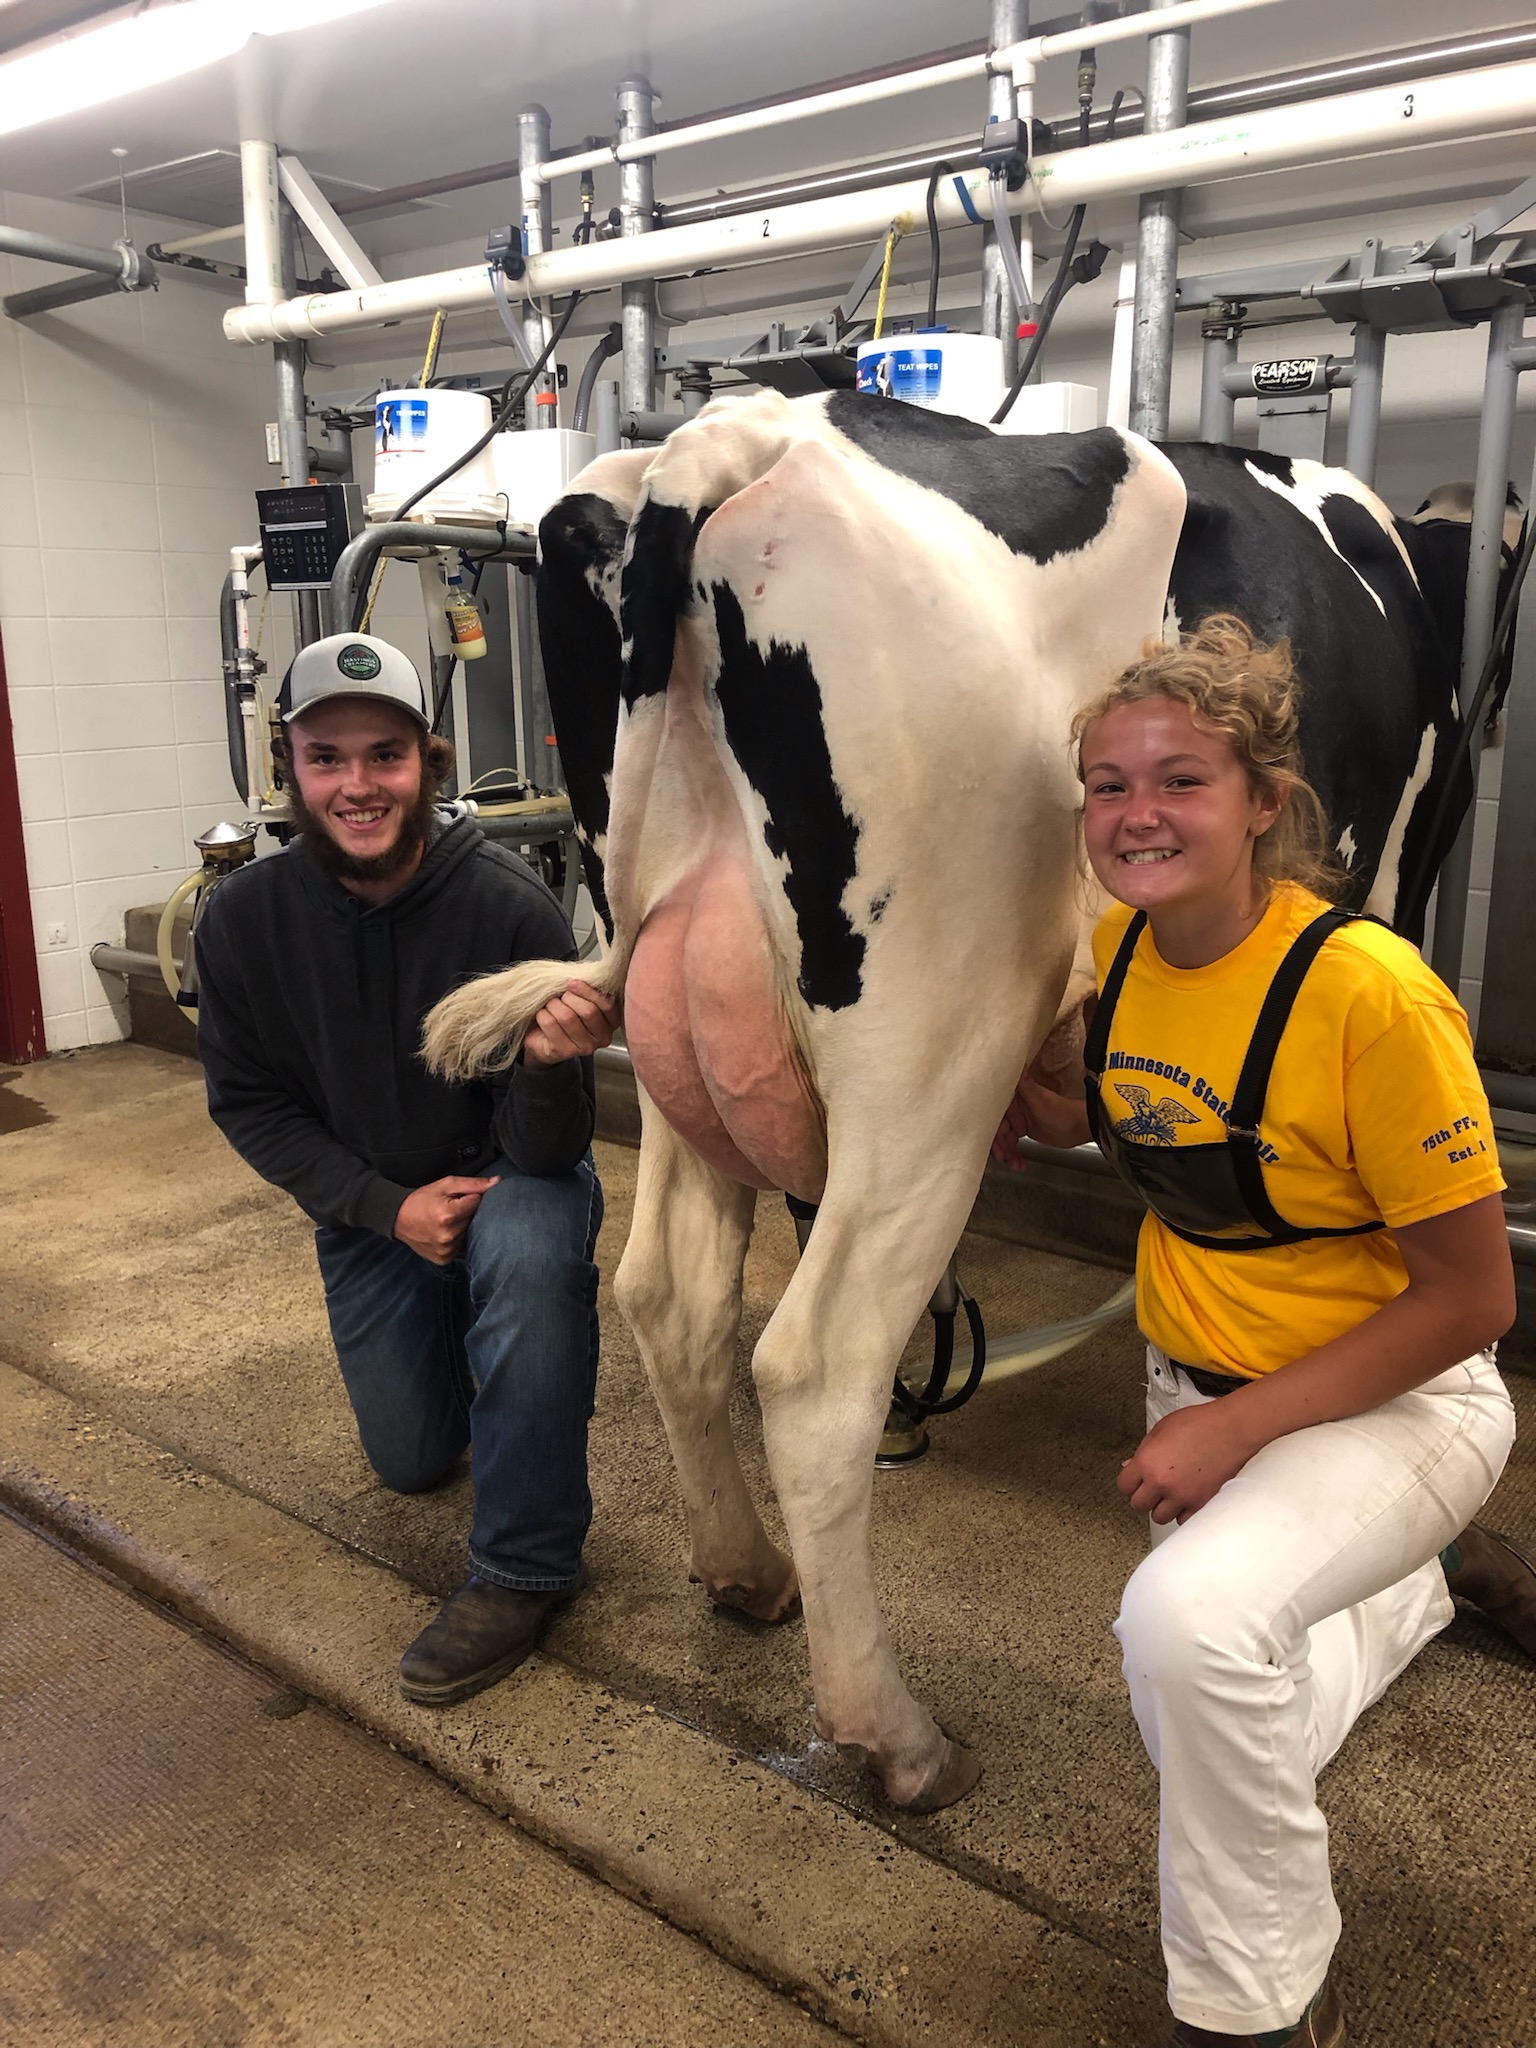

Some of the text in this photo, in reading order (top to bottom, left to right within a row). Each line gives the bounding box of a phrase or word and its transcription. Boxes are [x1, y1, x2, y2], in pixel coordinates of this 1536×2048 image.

[1403, 94, 1414, 118] 3
[763, 219, 770, 237] 2
[358, 296, 363, 311] 1
[898, 362, 939, 371] TEAT WIPES
[1254, 360, 1315, 378] PEARSON
[858, 376, 873, 388] Check
[1108, 1051, 1191, 1088] Minnesota
[1421, 1129, 1452, 1153] 75th
[1447, 1146, 1477, 1164] Est.
